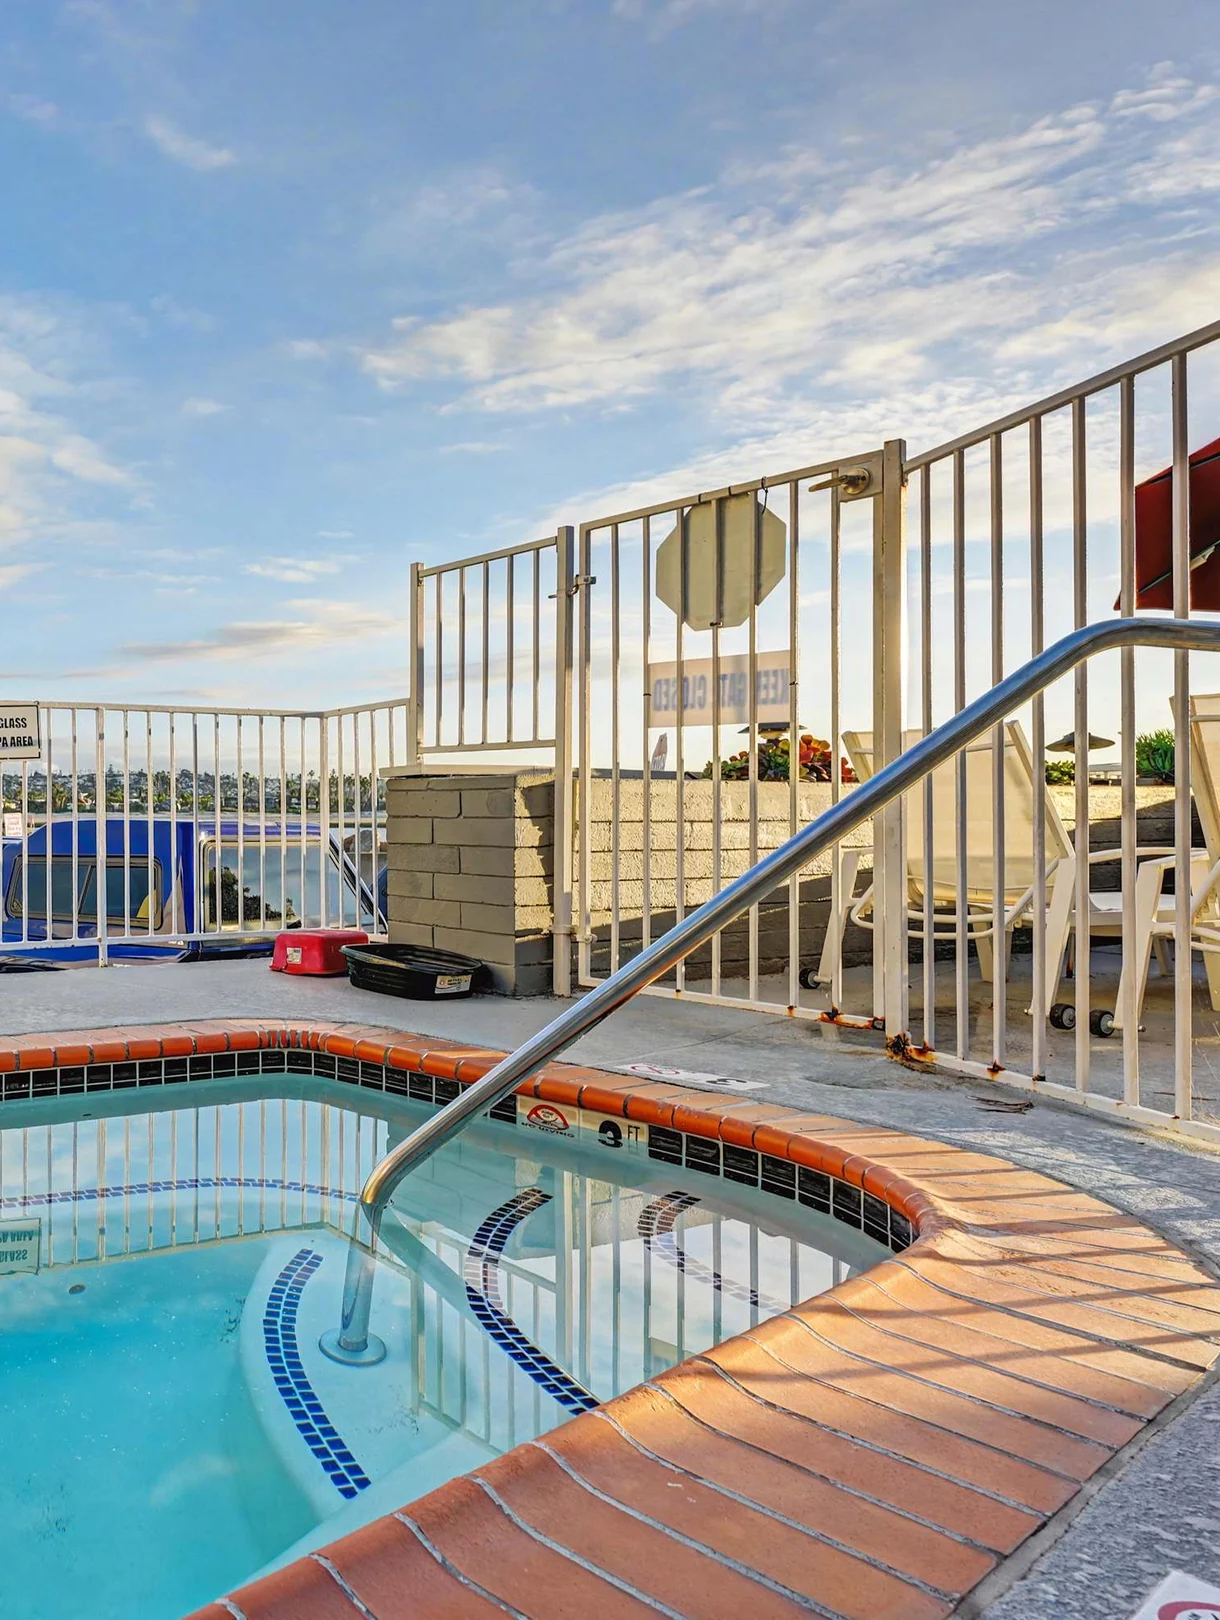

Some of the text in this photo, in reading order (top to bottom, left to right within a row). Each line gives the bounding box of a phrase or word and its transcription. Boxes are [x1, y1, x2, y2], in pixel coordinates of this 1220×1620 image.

[10, 736, 33, 747] AREA
[597, 1120, 640, 1149] 3 FT
